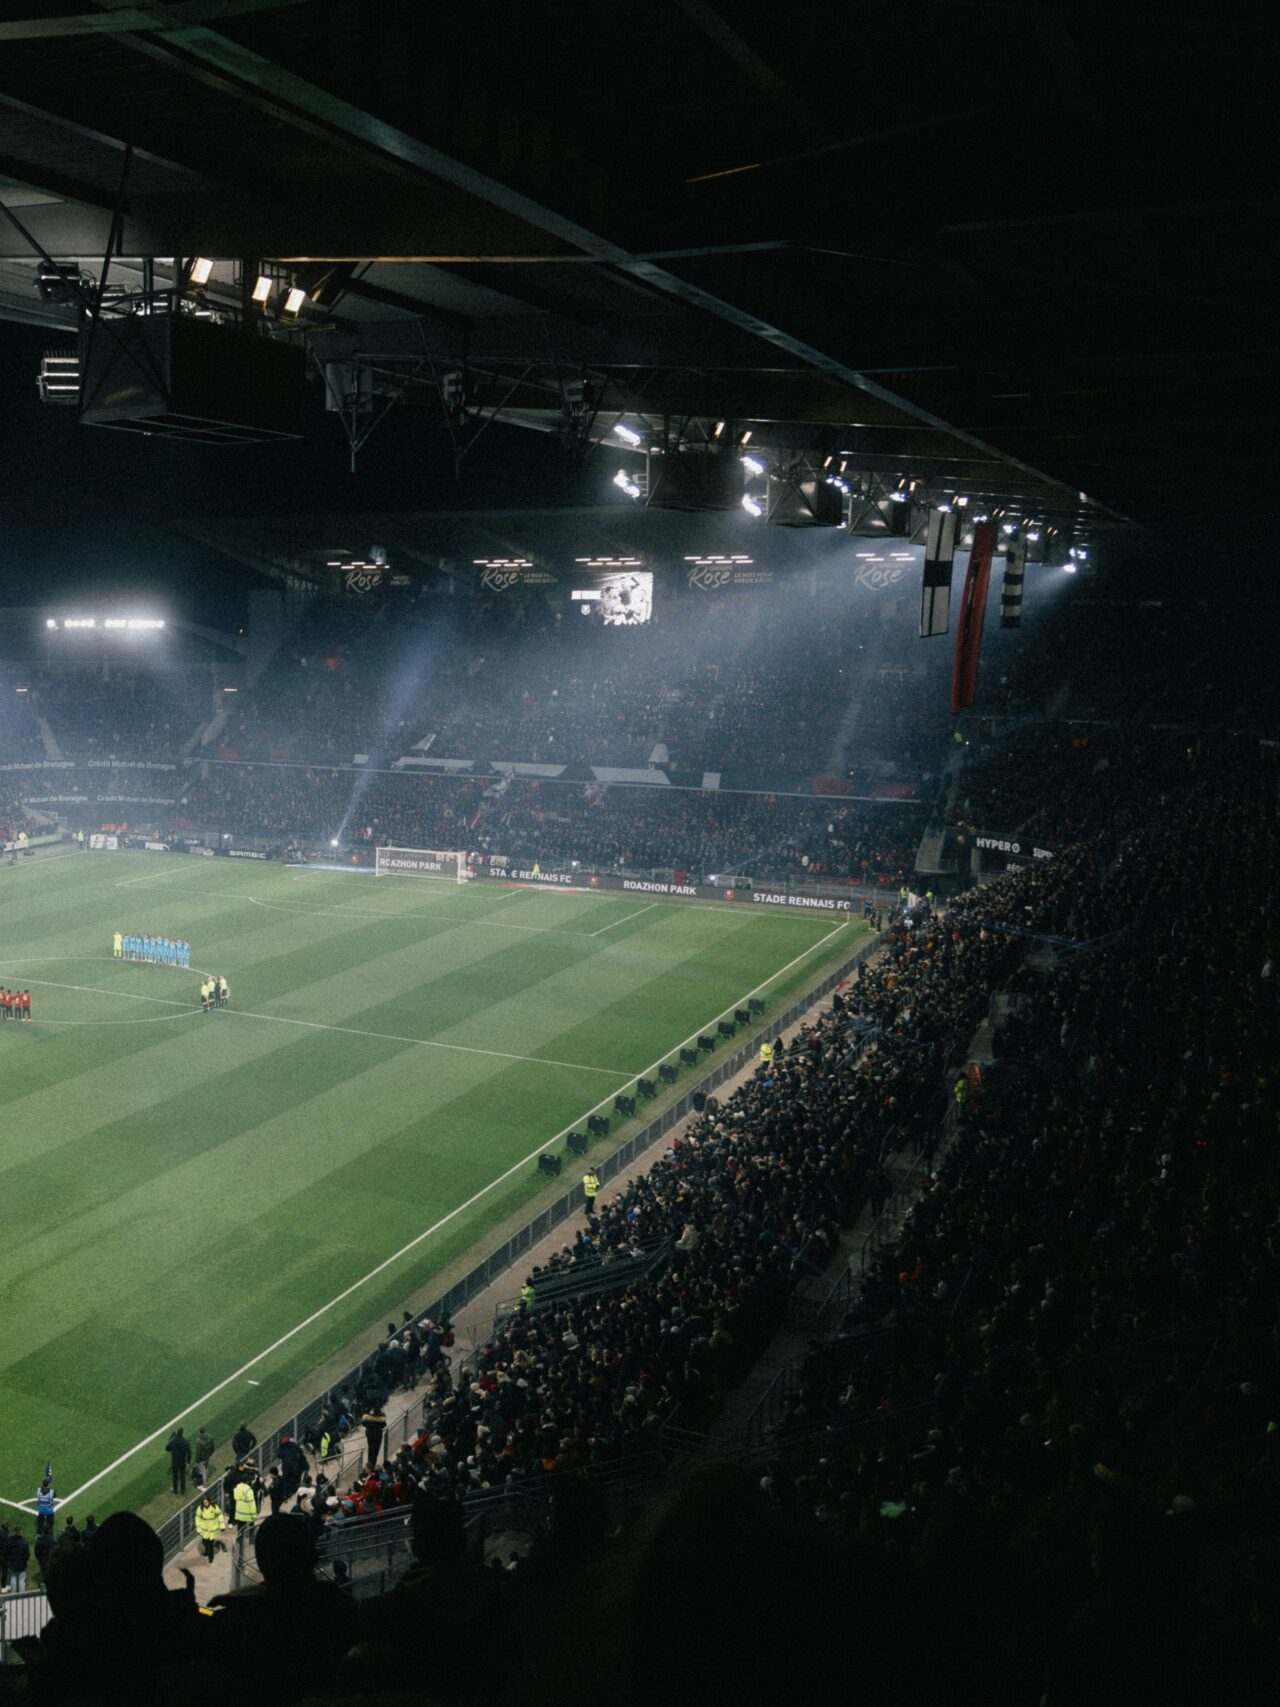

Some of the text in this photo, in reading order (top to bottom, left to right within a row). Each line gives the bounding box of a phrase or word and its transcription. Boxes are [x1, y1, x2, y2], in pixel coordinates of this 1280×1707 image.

[976, 837, 1011, 852] HYPER
[419, 862, 442, 872] PARK
[489, 868, 517, 878] STAE
[559, 875, 572, 883] FC
[623, 880, 697, 896] ROAZHON PARK
[753, 892, 851, 910] STADE RENNAIS FC
